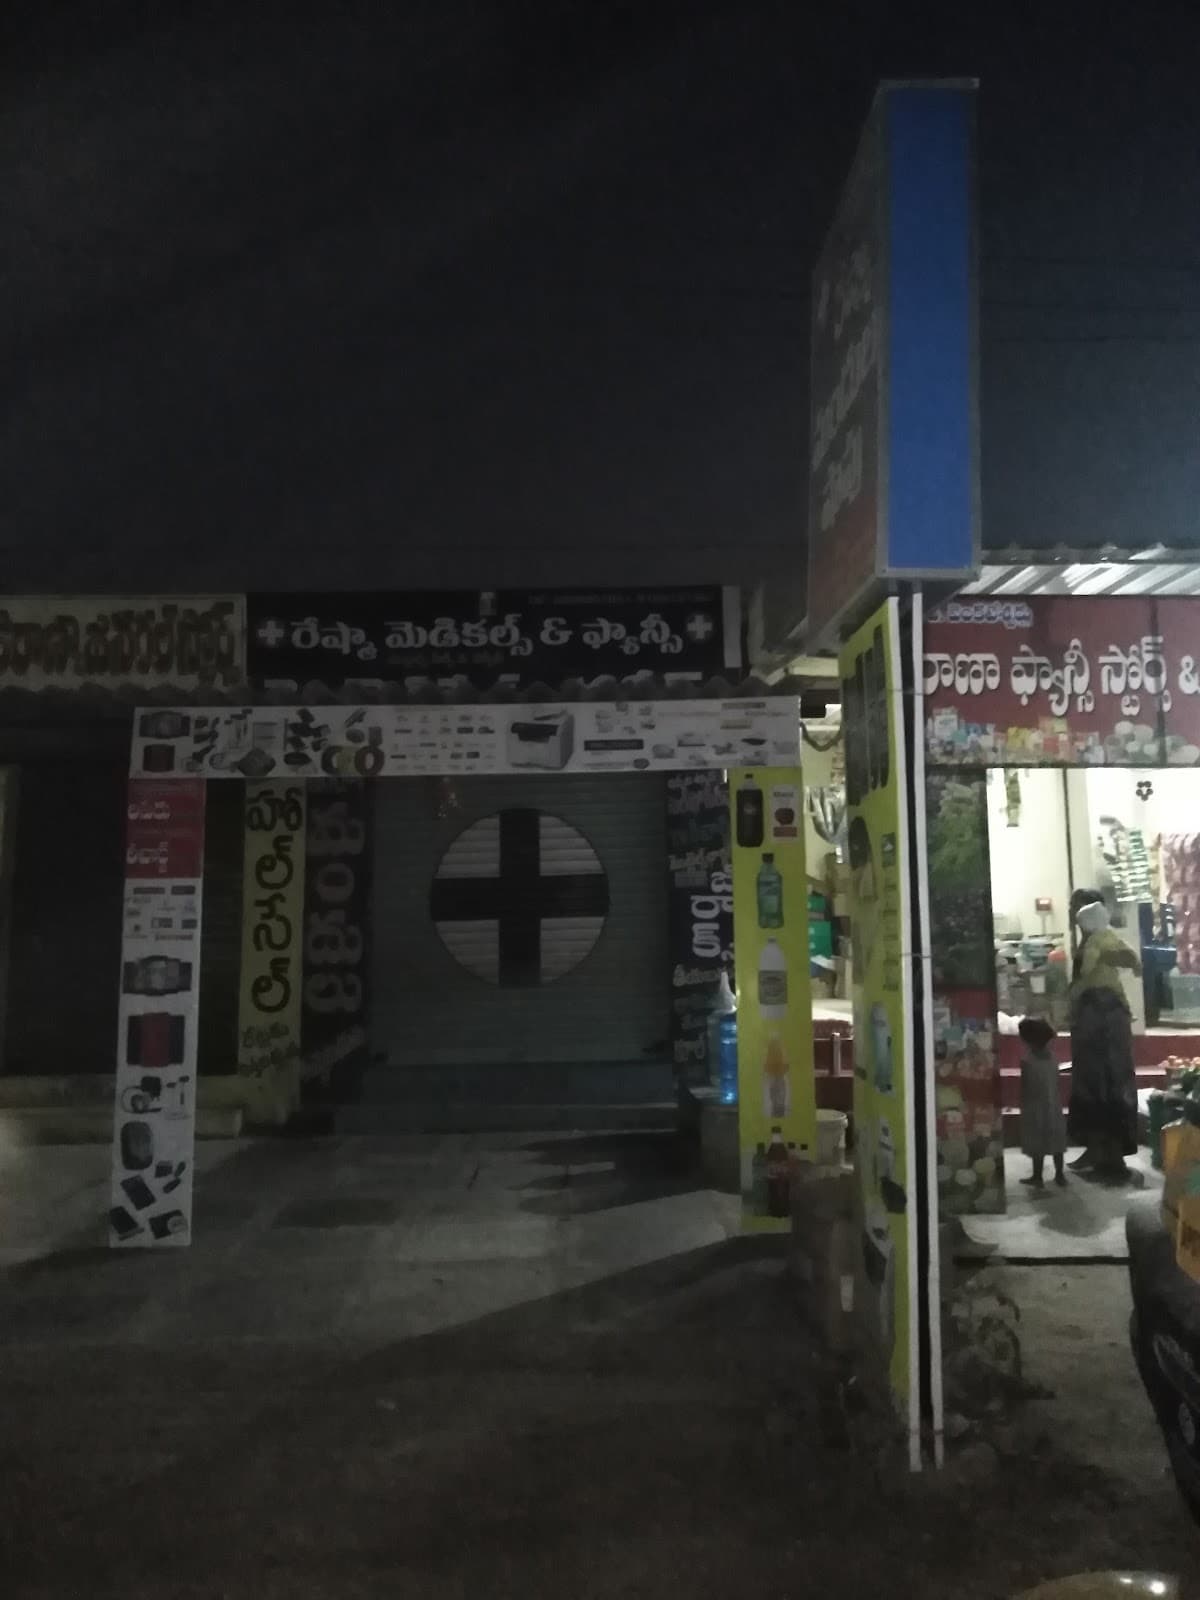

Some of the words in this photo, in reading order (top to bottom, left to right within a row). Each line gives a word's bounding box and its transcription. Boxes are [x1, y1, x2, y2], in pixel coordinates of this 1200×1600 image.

[384, 613, 533, 657] మెడికల్స్
[539, 616, 573, 646] &
[581, 613, 684, 656] ఫ్యాన్సీ
[1010, 638, 1095, 716] ఫ్యాన్సీ
